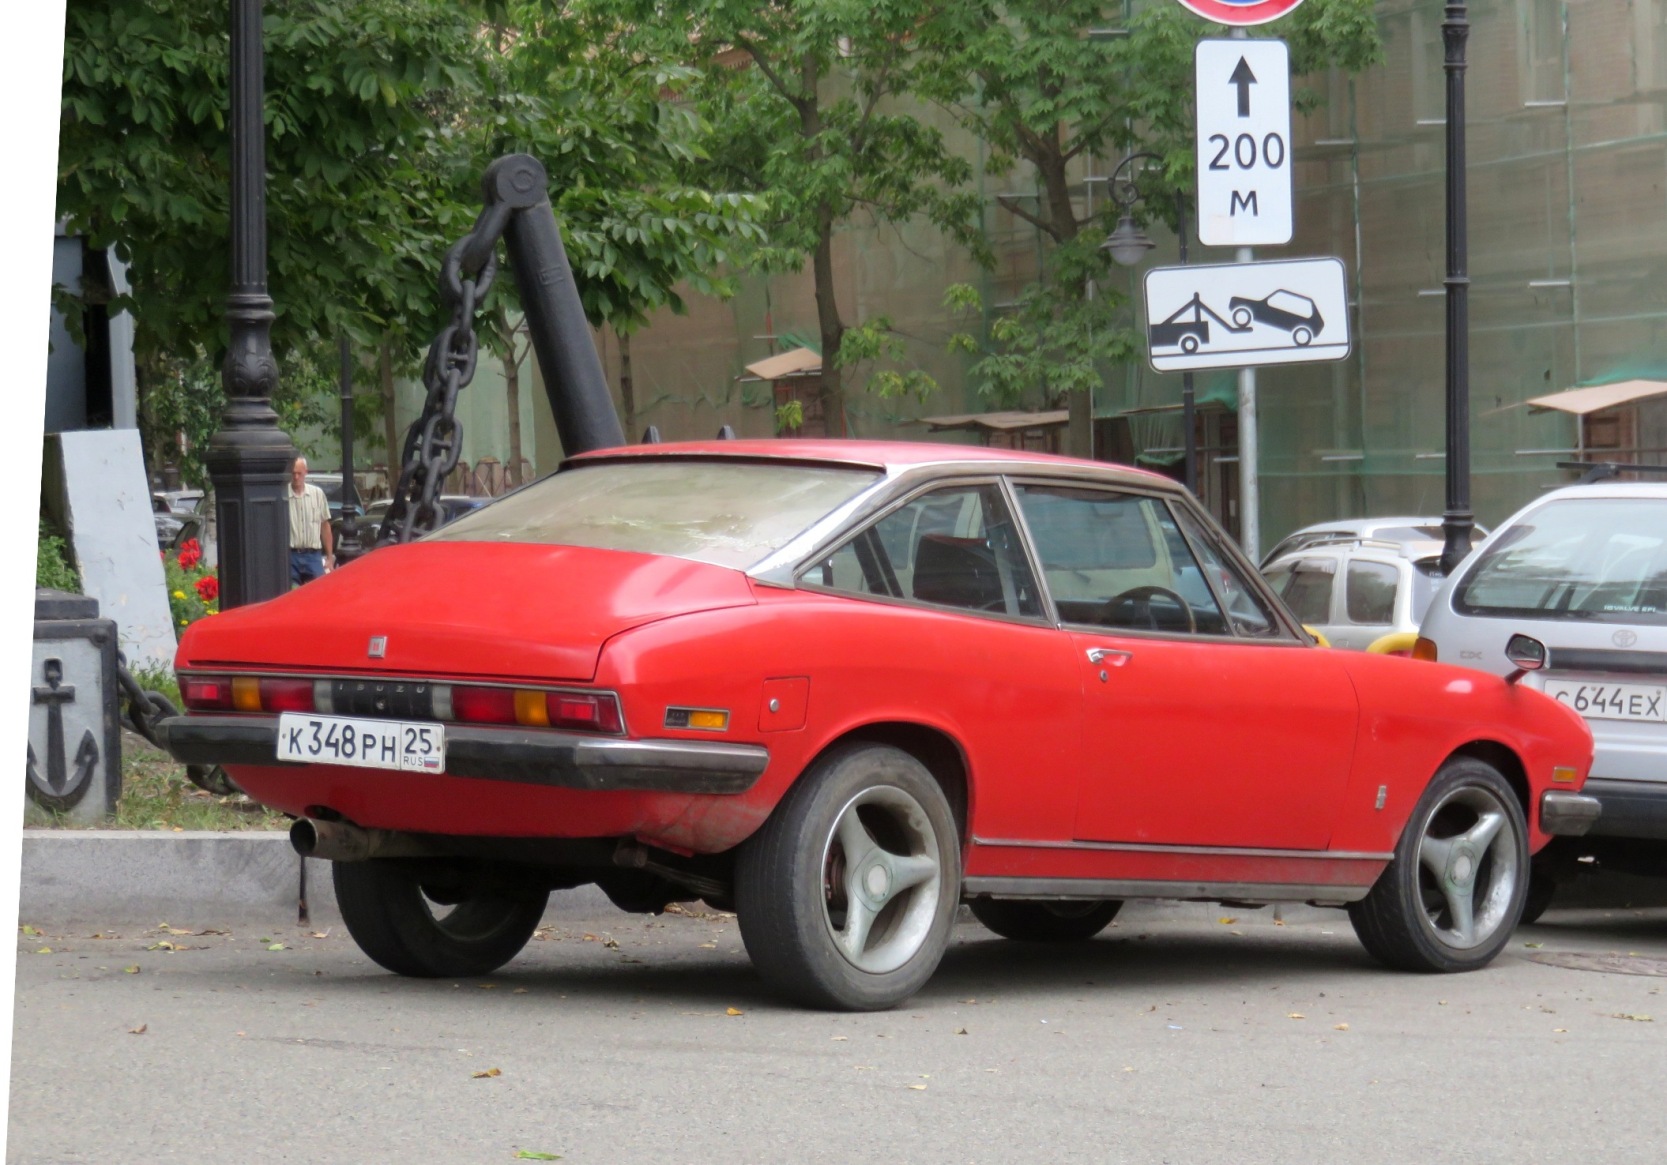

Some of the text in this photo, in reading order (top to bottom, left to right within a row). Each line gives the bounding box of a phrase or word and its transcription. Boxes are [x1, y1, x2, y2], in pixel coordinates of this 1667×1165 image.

[1208, 132, 1285, 171] 200
[339, 683, 425, 694] ISUZU
[404, 728, 433, 755] 25
[403, 756, 424, 767] RUS
